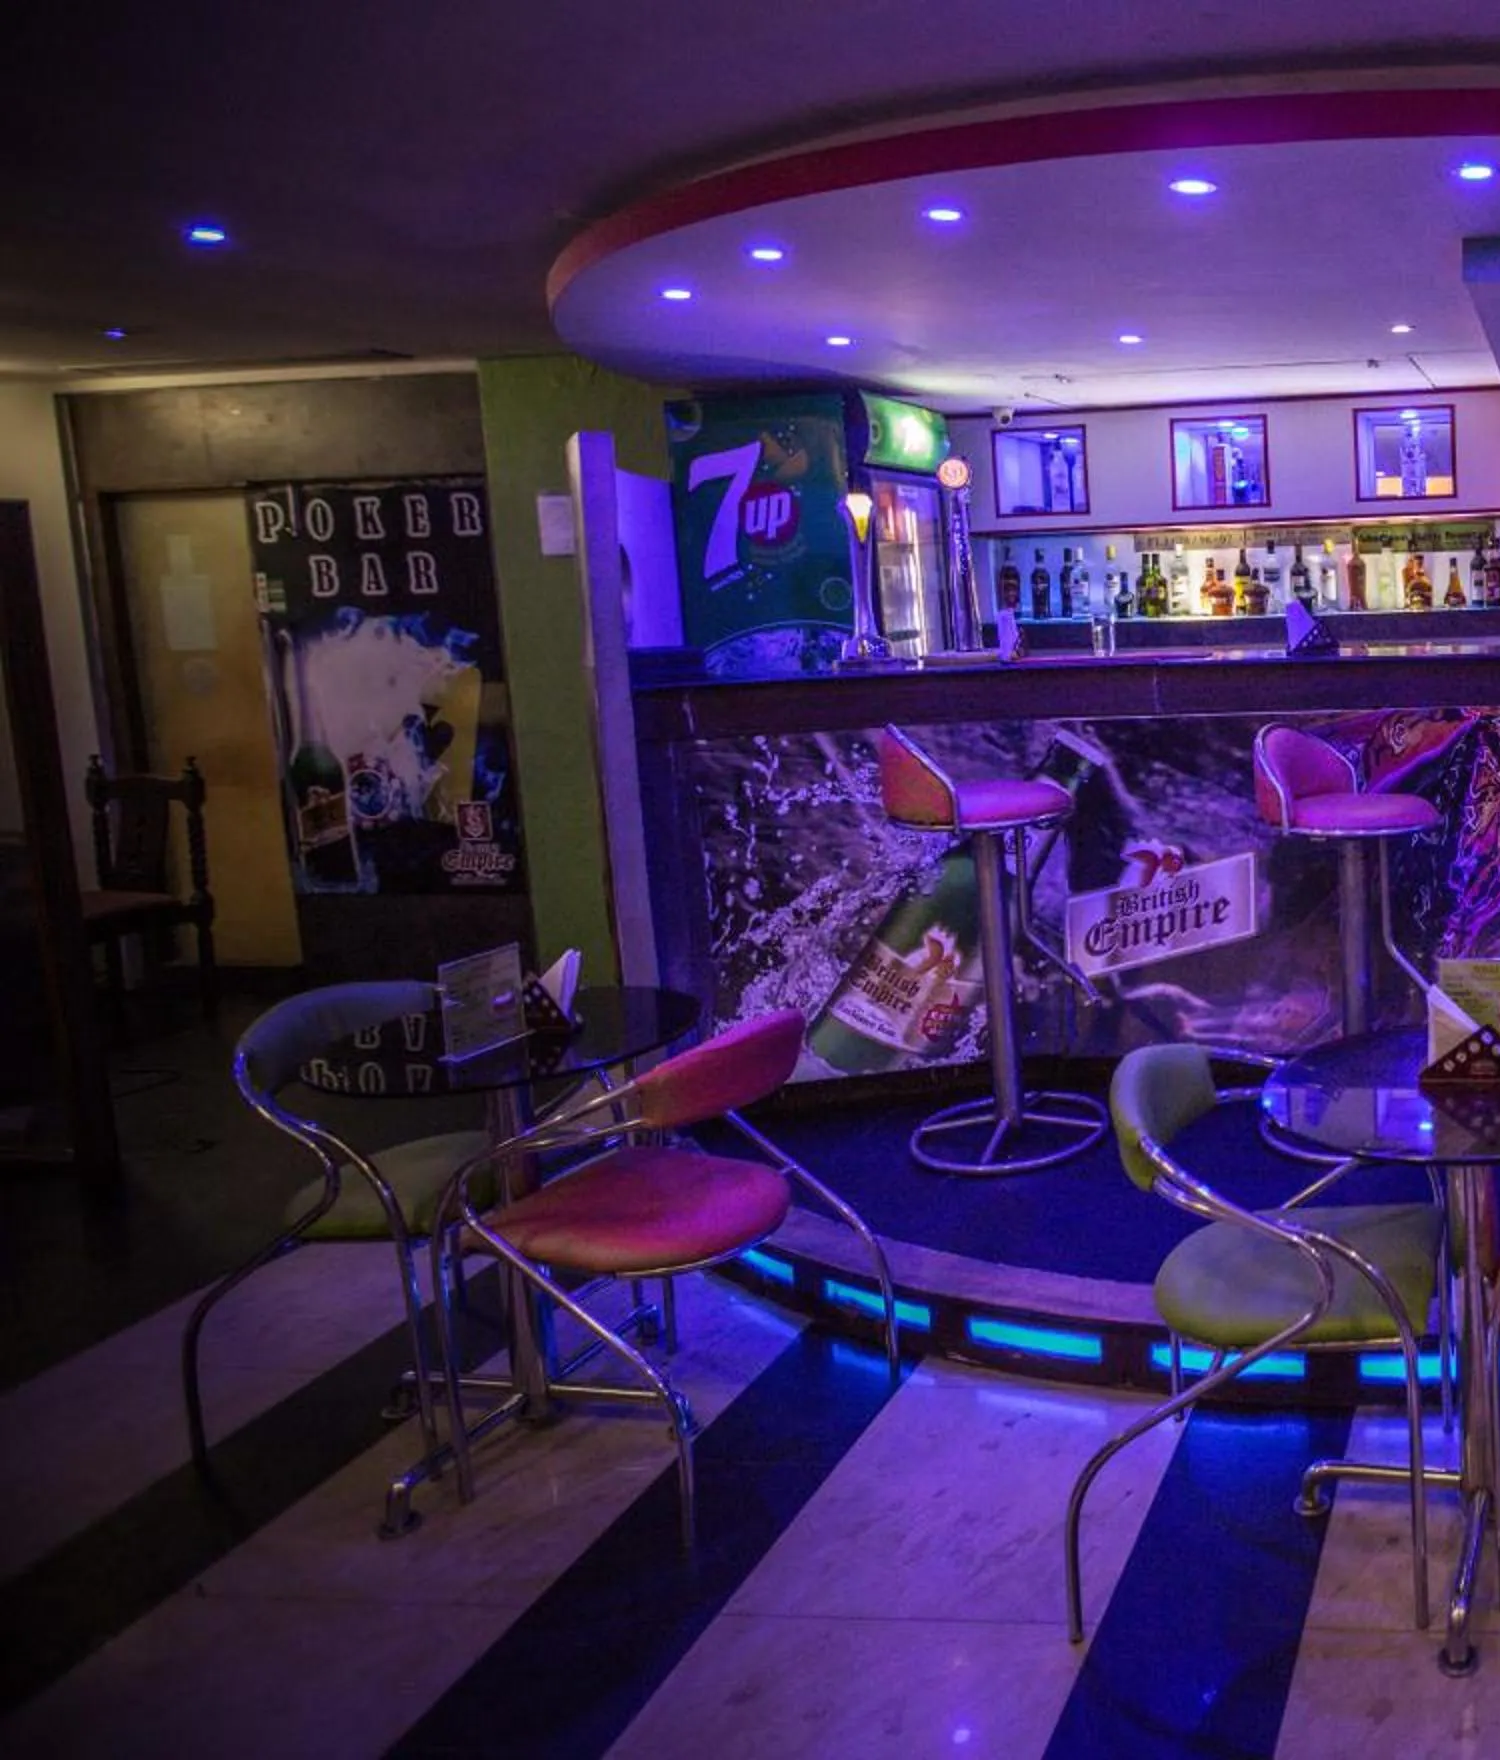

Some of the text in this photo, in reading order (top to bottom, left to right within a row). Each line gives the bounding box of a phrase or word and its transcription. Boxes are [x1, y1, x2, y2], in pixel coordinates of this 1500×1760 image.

[255, 492, 483, 543] POKER
[308, 551, 439, 597] BAR
[1118, 879, 1200, 918] British
[1084, 896, 1230, 957] Empire
